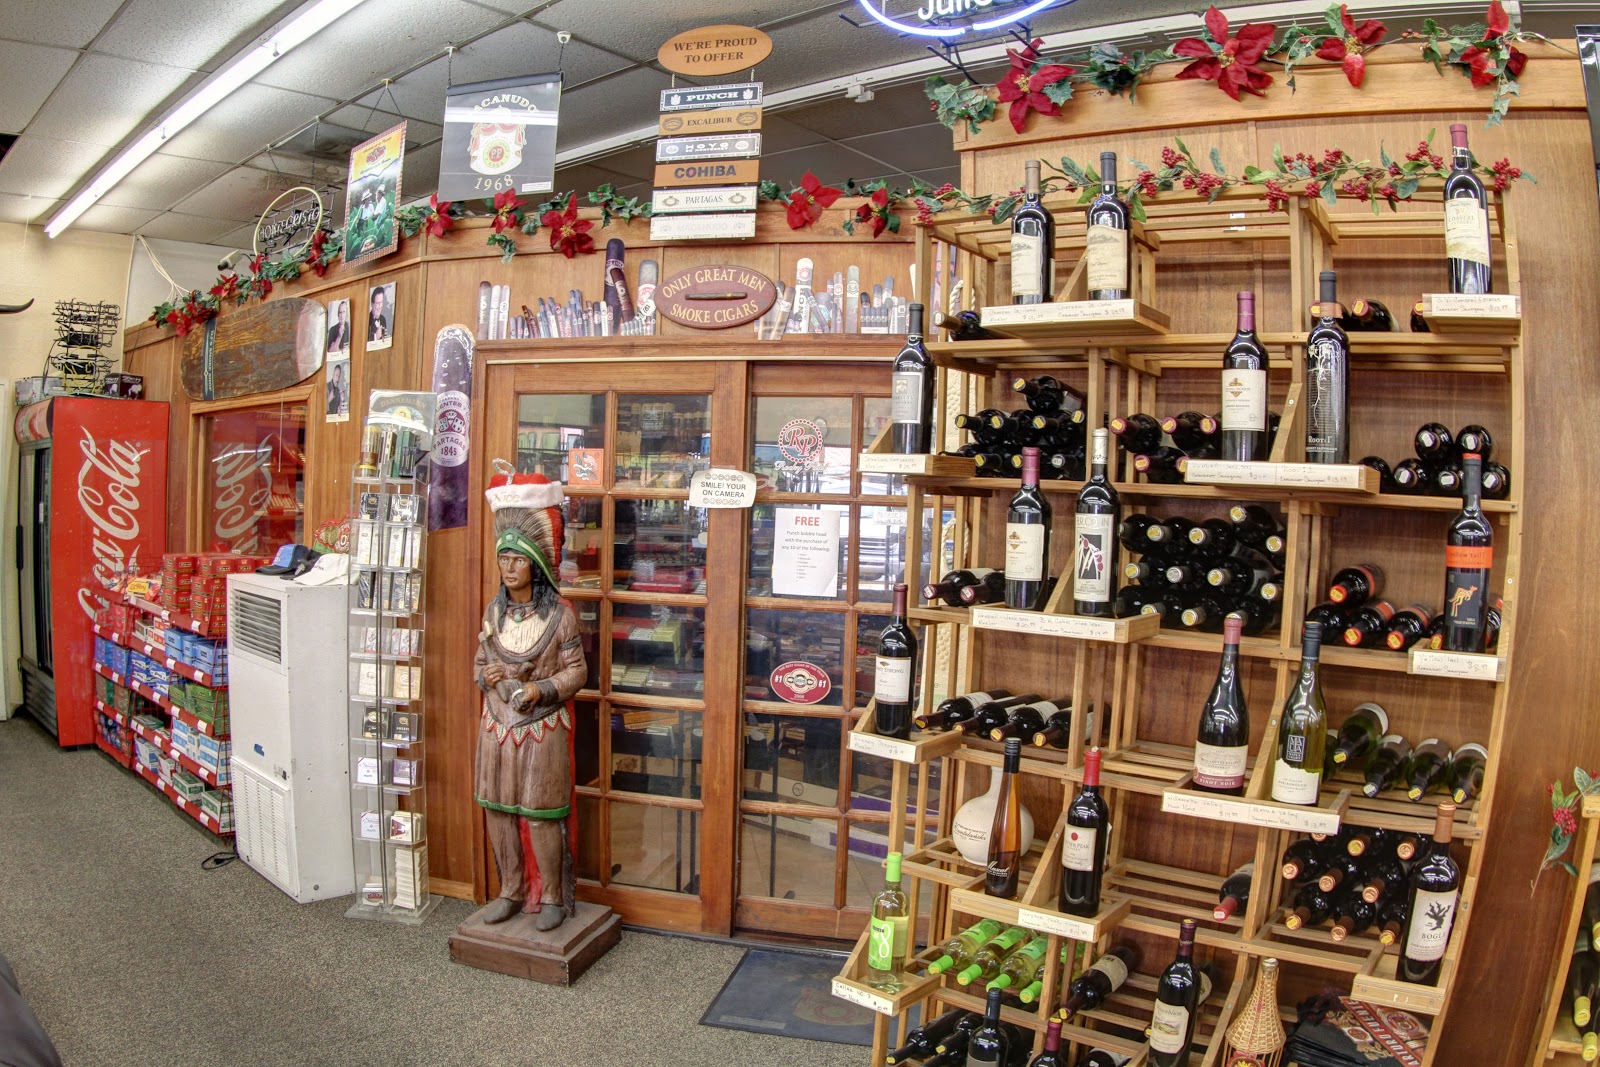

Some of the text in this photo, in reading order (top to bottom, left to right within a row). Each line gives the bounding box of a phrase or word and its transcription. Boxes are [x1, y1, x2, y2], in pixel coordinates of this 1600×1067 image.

[674, 37, 758, 52] WE'RE PROUD
[684, 51, 744, 63] TO OFFER
[686, 91, 738, 102] PUNCH
[687, 117, 733, 126] EXCALIBUR
[685, 142, 729, 150] HOYO
[674, 165, 737, 179] COHIBA
[474, 174, 514, 192] 1968
[685, 195, 723, 205] PARTAGAS
[662, 274, 692, 298] ONLY
[695, 268, 737, 283] GREAT
[738, 271, 767, 293] MEN
[670, 300, 759, 324] SMOKE CIGARS
[440, 446, 458, 457] 1845
[700, 481, 747, 491] SMILE! YOUR
[702, 489, 746, 498] ON CAMERA
[794, 516, 821, 527] FREE
[774, 674, 783, 684] #1
[818, 679, 827, 689] #1
[1199, 778, 1218, 786] PINOT
[1346, 999, 1421, 1066] ARTURO FUENTE
